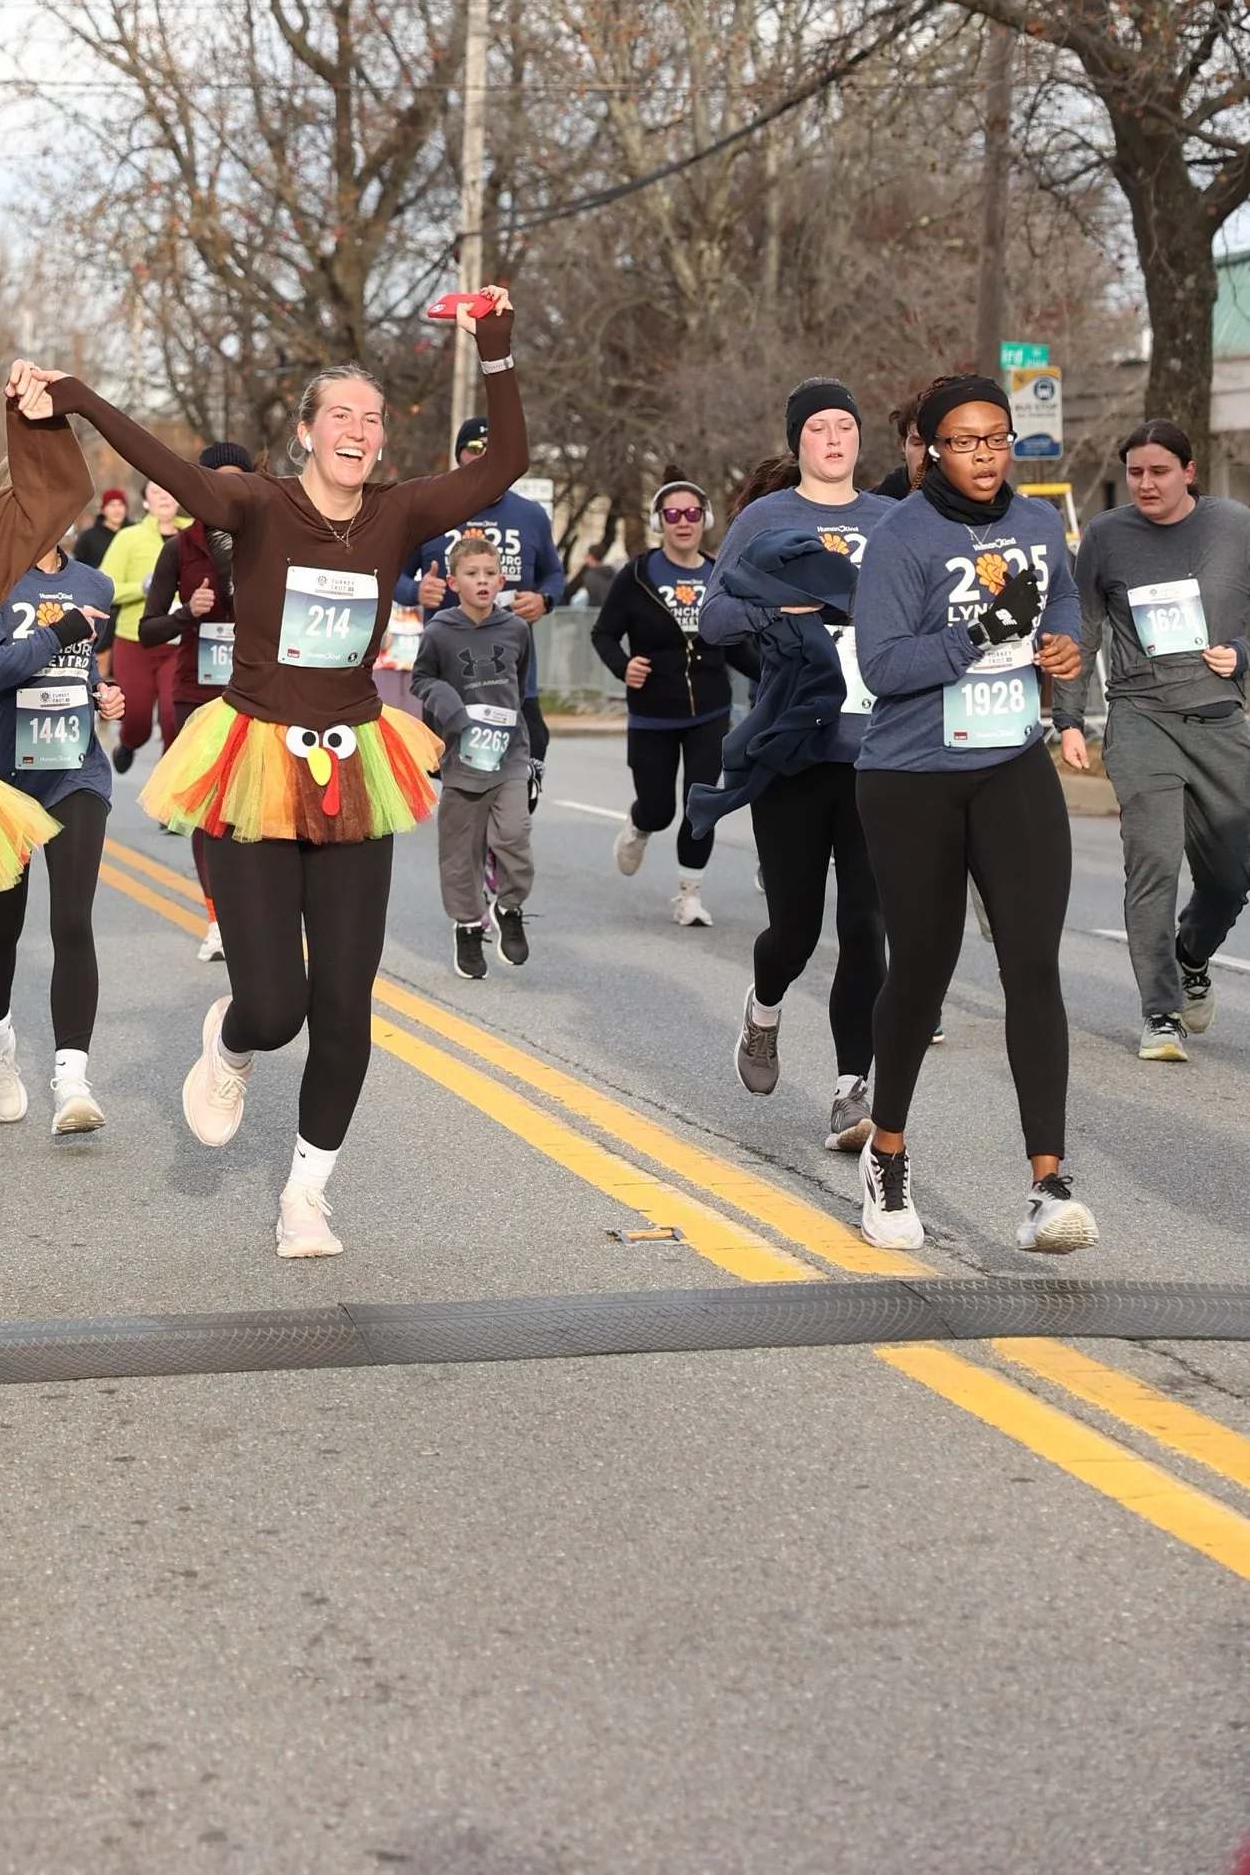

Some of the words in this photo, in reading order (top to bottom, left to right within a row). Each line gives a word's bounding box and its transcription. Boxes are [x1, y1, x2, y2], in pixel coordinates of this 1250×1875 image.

[306, 605, 351, 639] 214
[1146, 607, 1193, 633] 1621
[961, 678, 1025, 717] 1928
[30, 715, 80, 744] 1443
[470, 726, 510, 753] 2263
